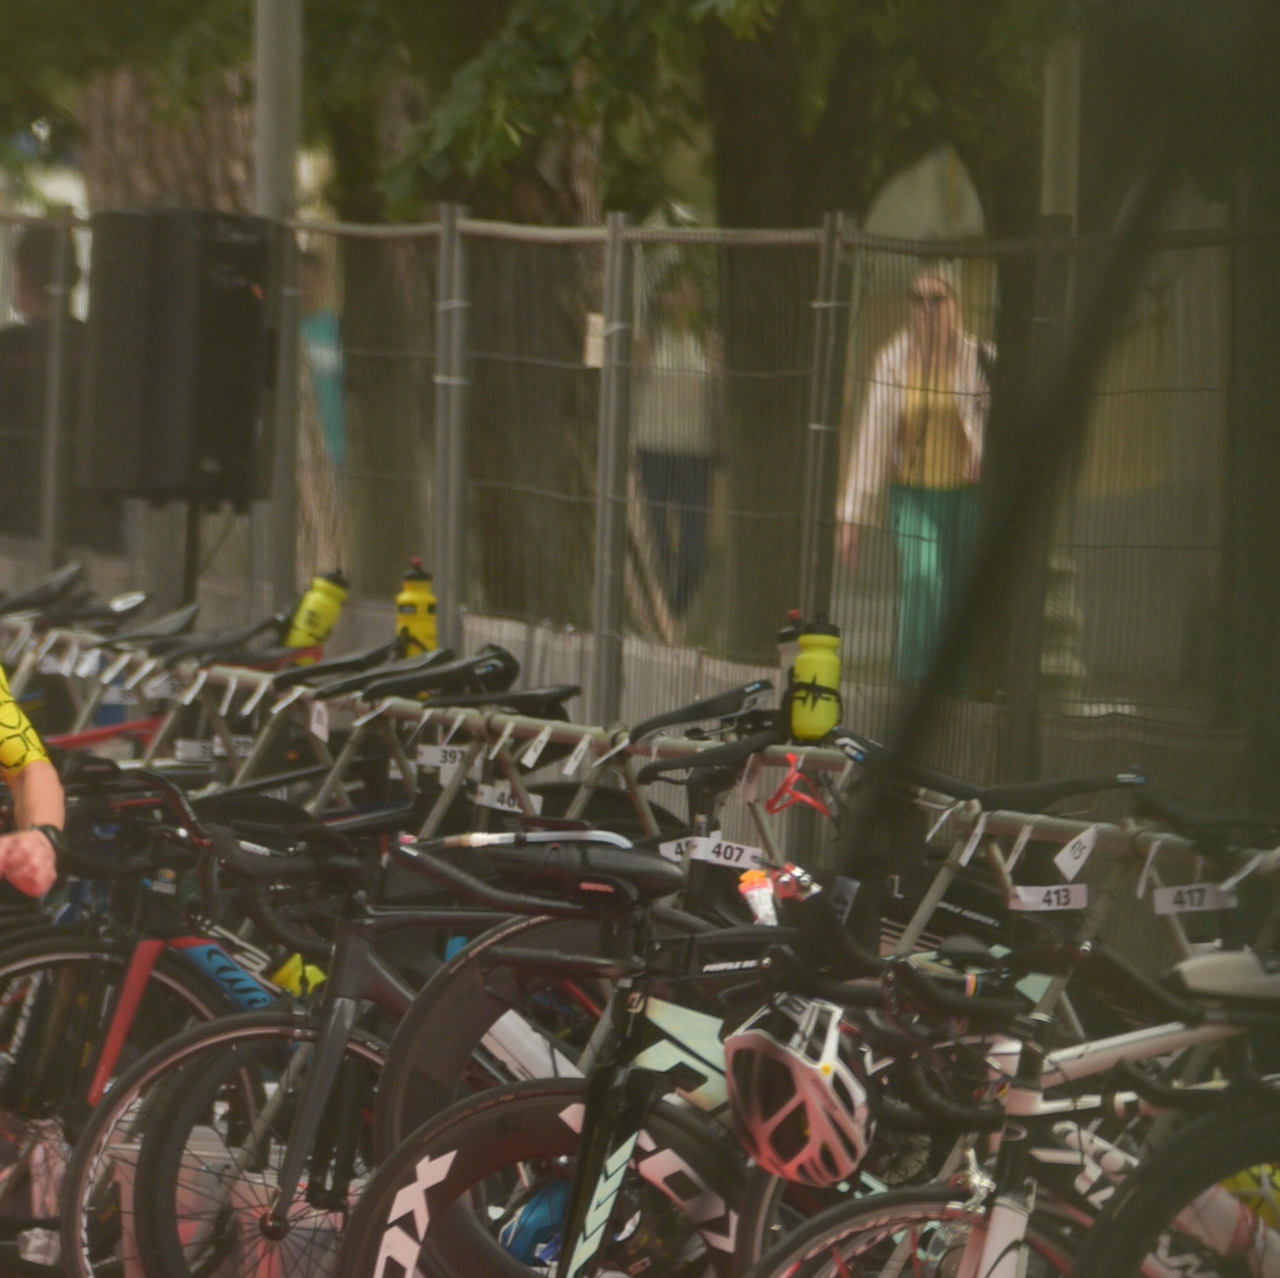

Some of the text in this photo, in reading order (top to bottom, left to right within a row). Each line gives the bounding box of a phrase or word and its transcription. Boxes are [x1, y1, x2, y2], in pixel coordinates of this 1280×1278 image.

[711, 842, 745, 863] 407
[1042, 888, 1071, 907] 413
[1173, 888, 1206, 908] 417
